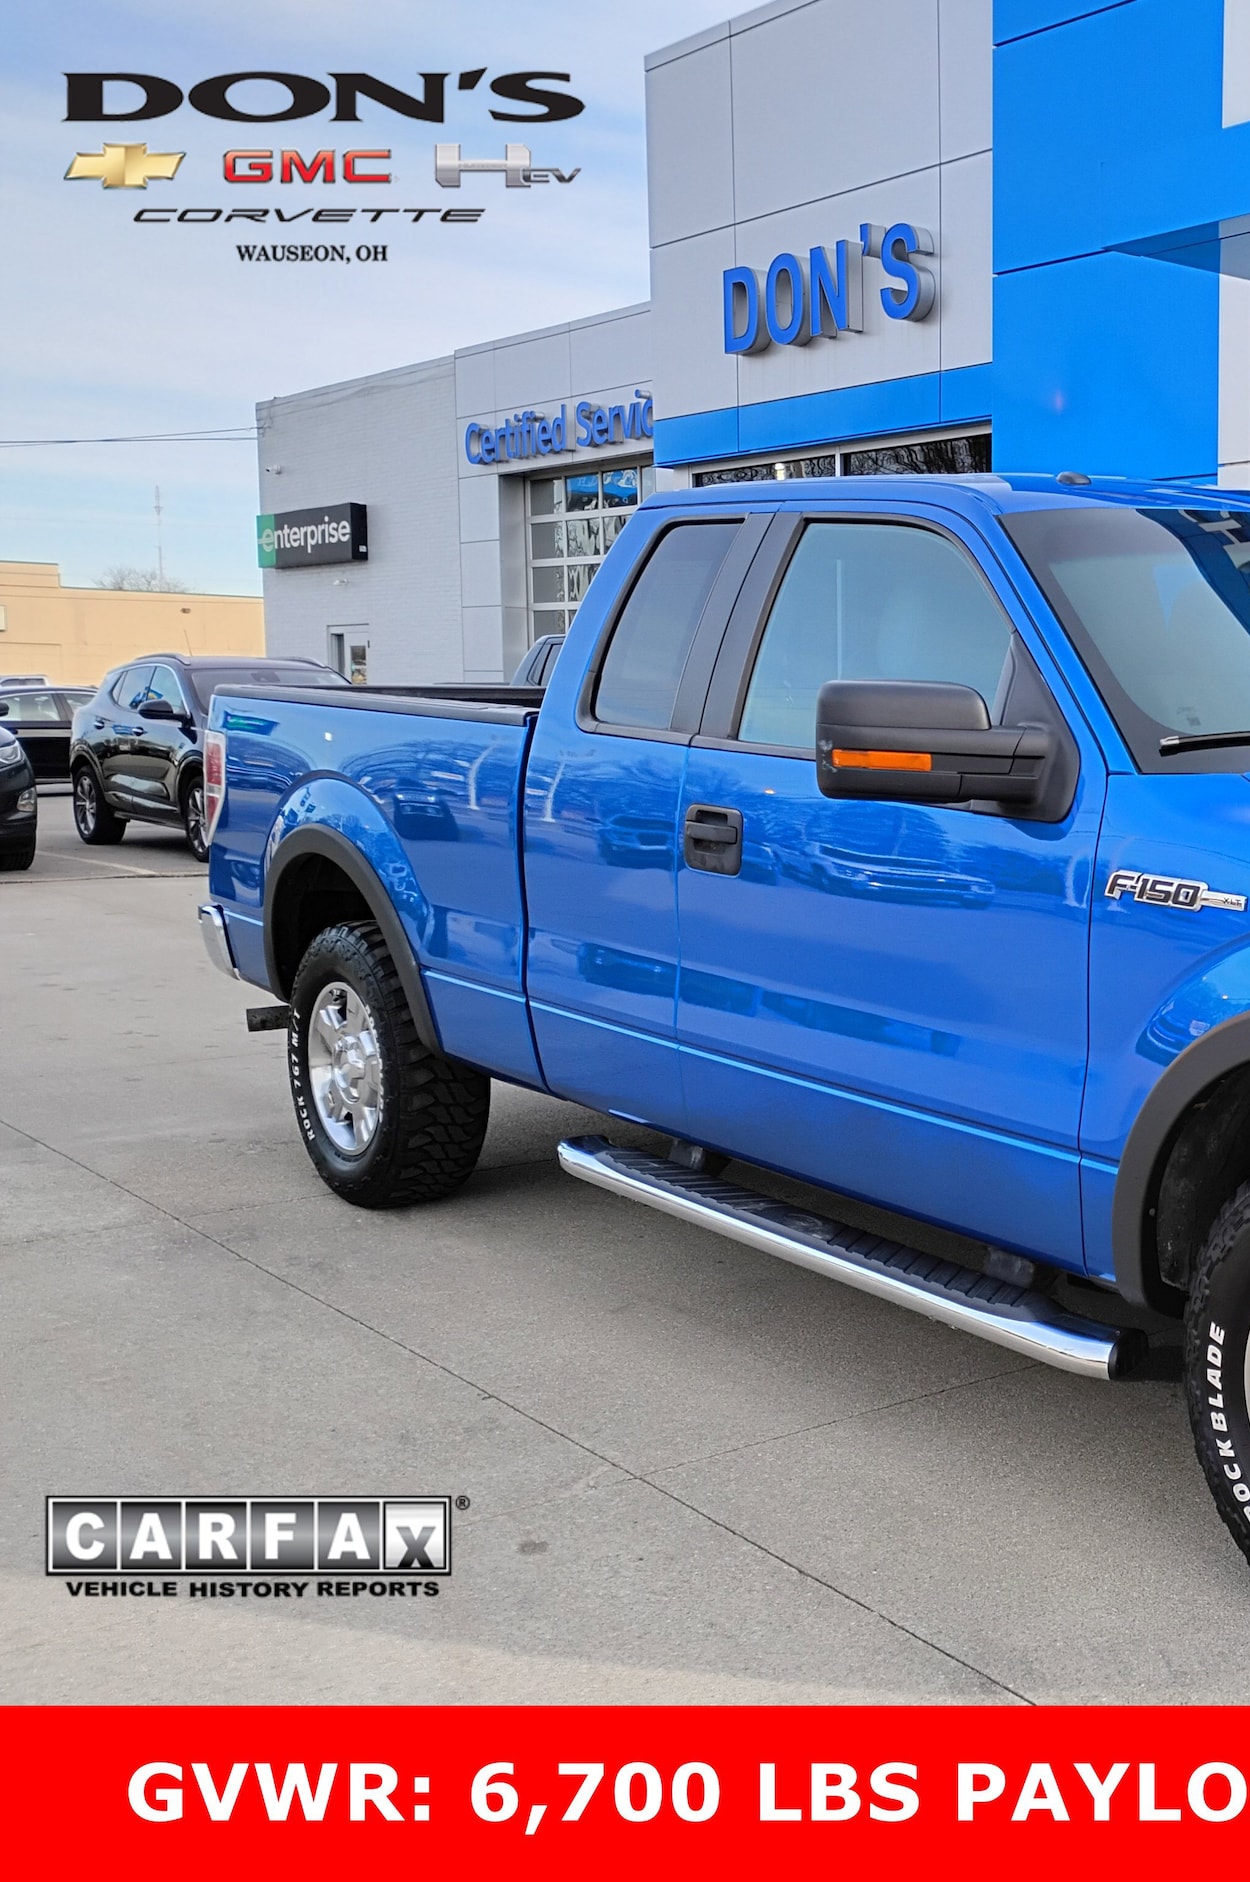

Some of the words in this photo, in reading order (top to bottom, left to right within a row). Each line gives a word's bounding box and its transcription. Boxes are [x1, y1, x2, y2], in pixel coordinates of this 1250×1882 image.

[723, 223, 933, 354] DON'S
[465, 404, 567, 465] Certified
[259, 516, 351, 553] enterprise
[1106, 871, 1204, 909] F-150
[297, 1095, 316, 1141] ROCK
